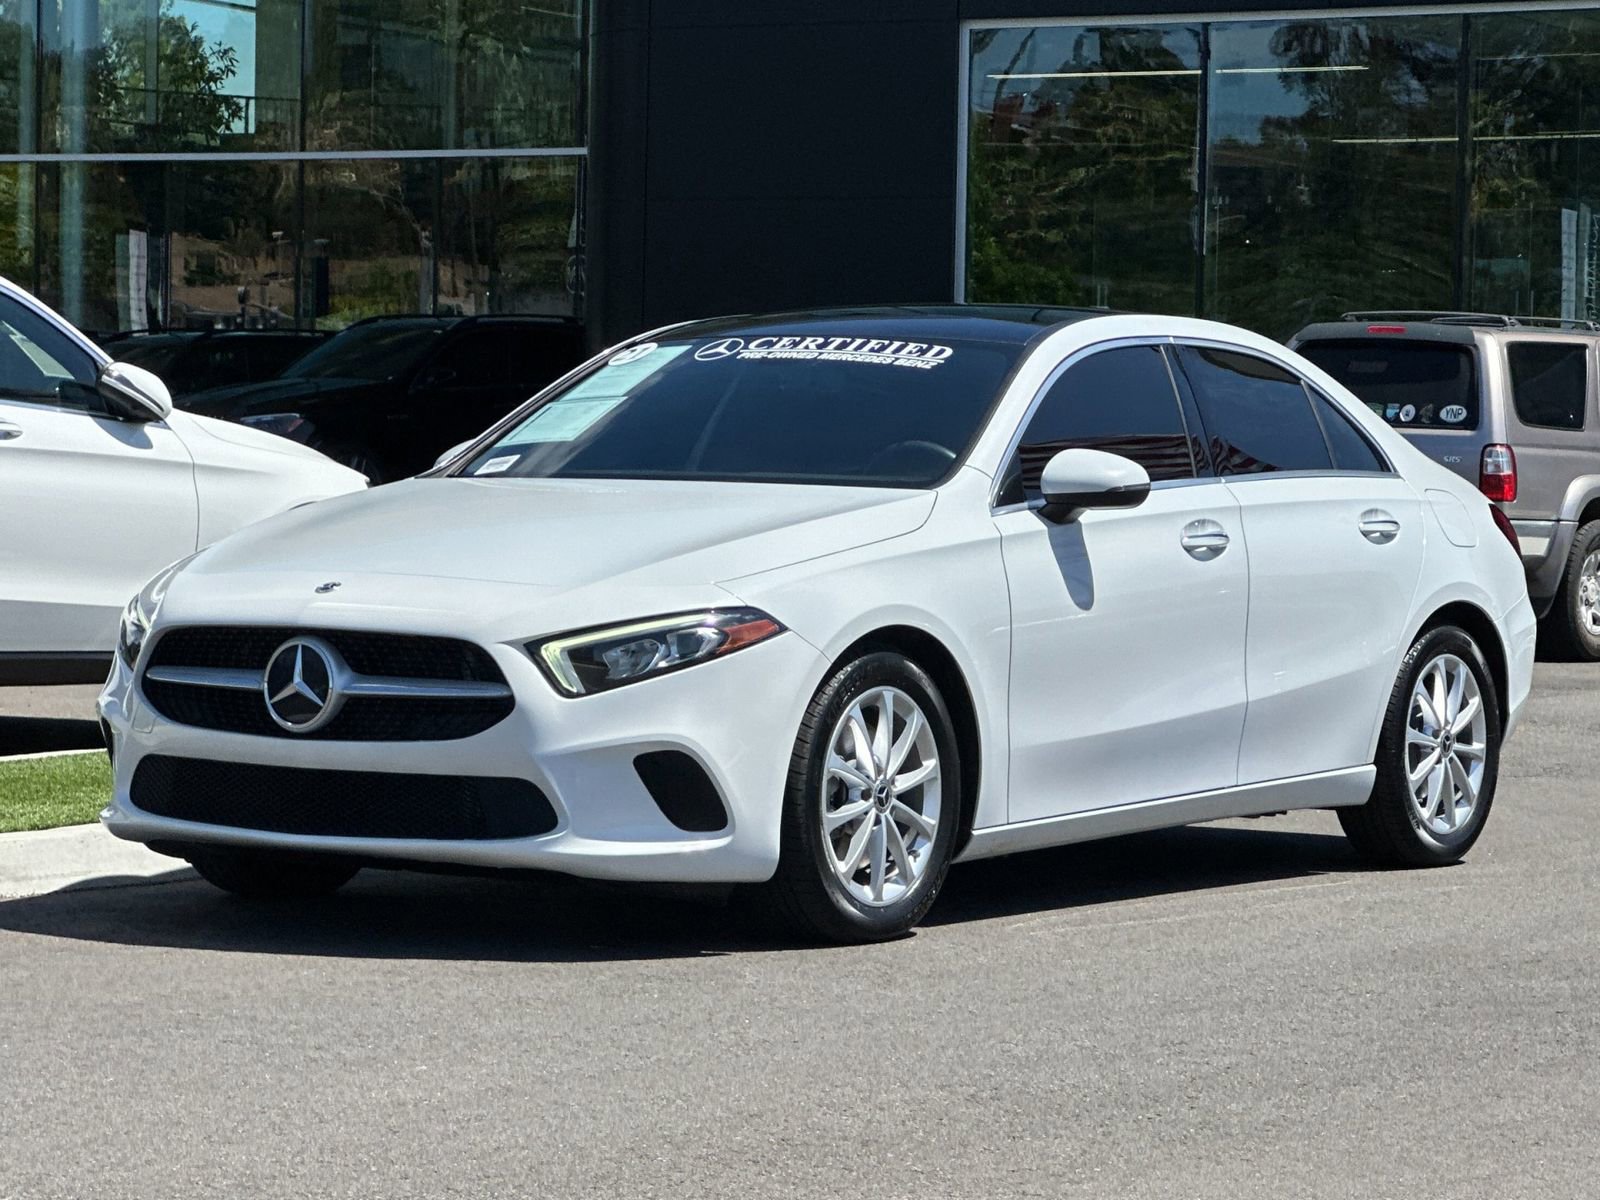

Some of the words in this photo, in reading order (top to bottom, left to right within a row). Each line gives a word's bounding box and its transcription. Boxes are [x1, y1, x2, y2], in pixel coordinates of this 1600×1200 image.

[747, 336, 953, 359] CERTIFIED
[736, 350, 817, 360] PRE-OWNED
[816, 352, 895, 364] MERCEDES
[892, 358, 938, 369] BENZ
[1445, 407, 1464, 419] YNP
